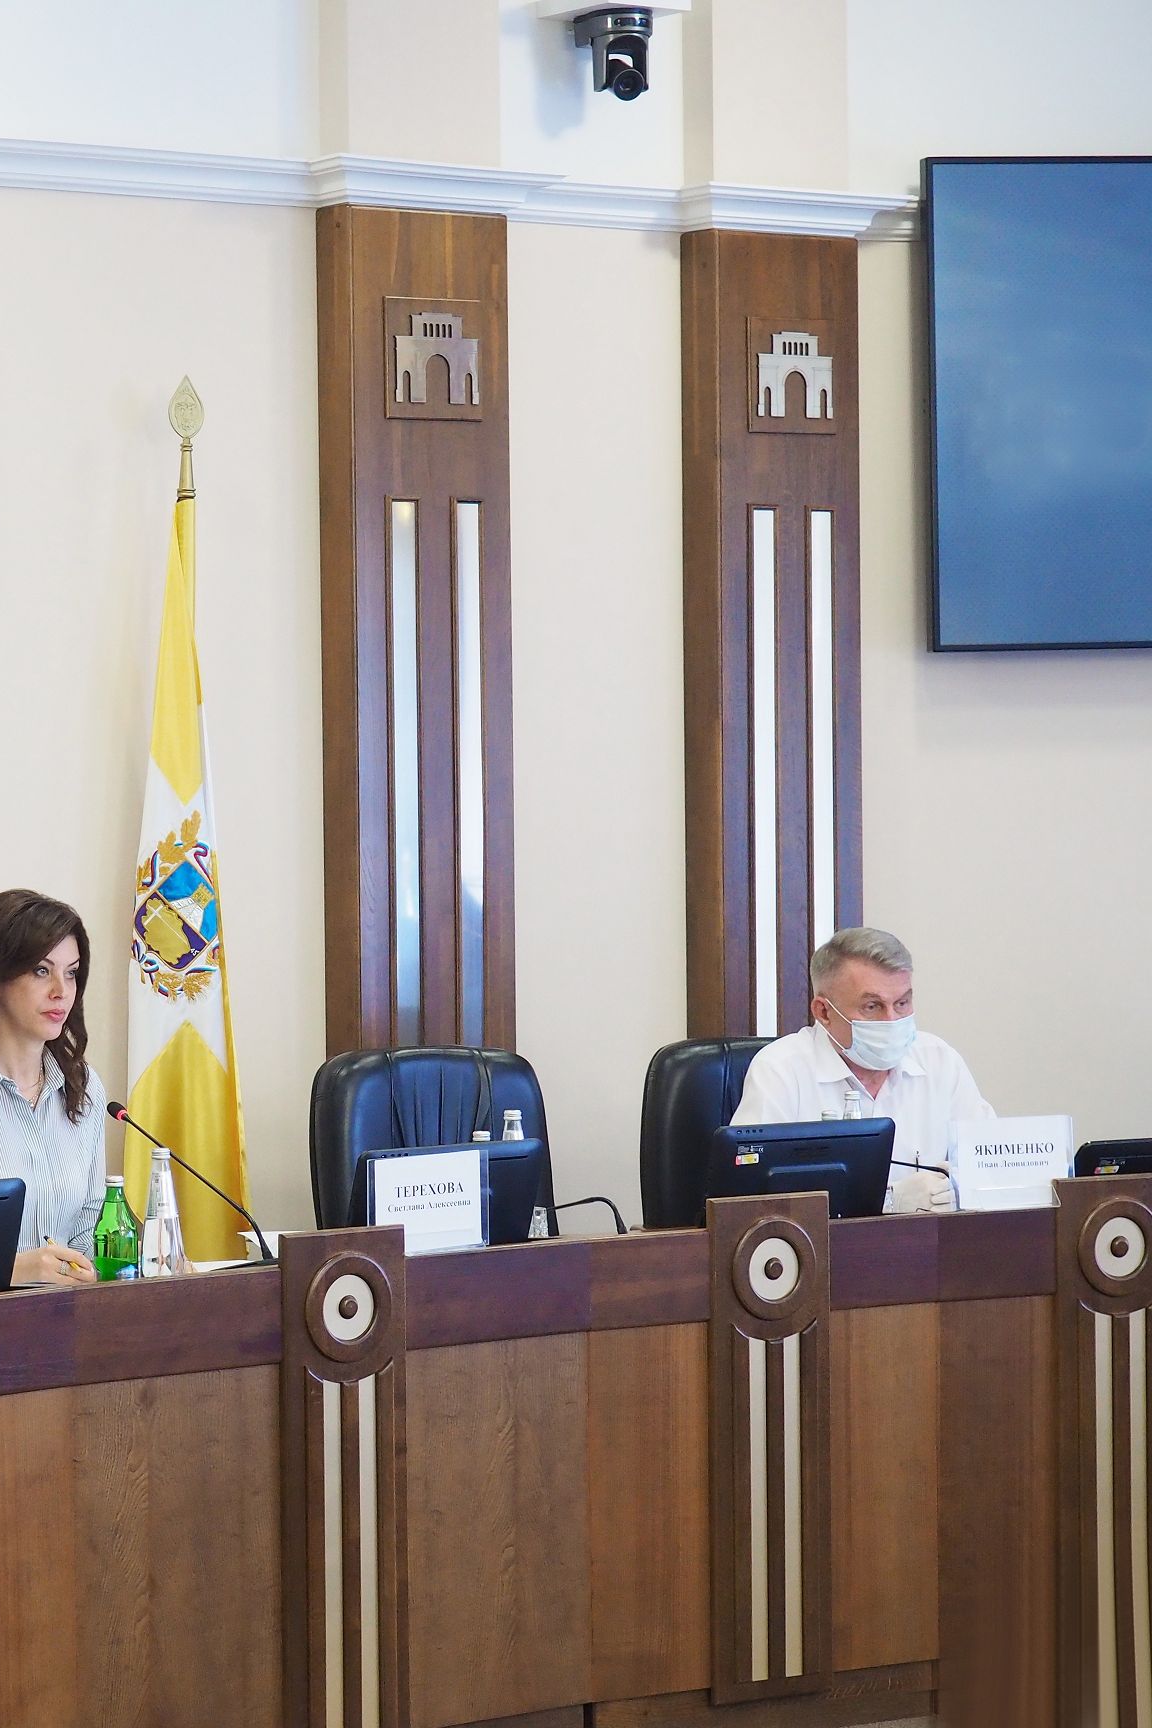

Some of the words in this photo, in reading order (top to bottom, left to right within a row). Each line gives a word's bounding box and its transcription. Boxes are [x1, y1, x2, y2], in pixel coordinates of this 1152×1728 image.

[975, 1142, 1054, 1156] ЯКИМЕНКО
[977, 1161, 999, 1169] Иван
[394, 1181, 464, 1198] ТЕРЕХОВА
[387, 1203, 425, 1213] Светлана
[427, 1199, 471, 1210] Алексеевна
